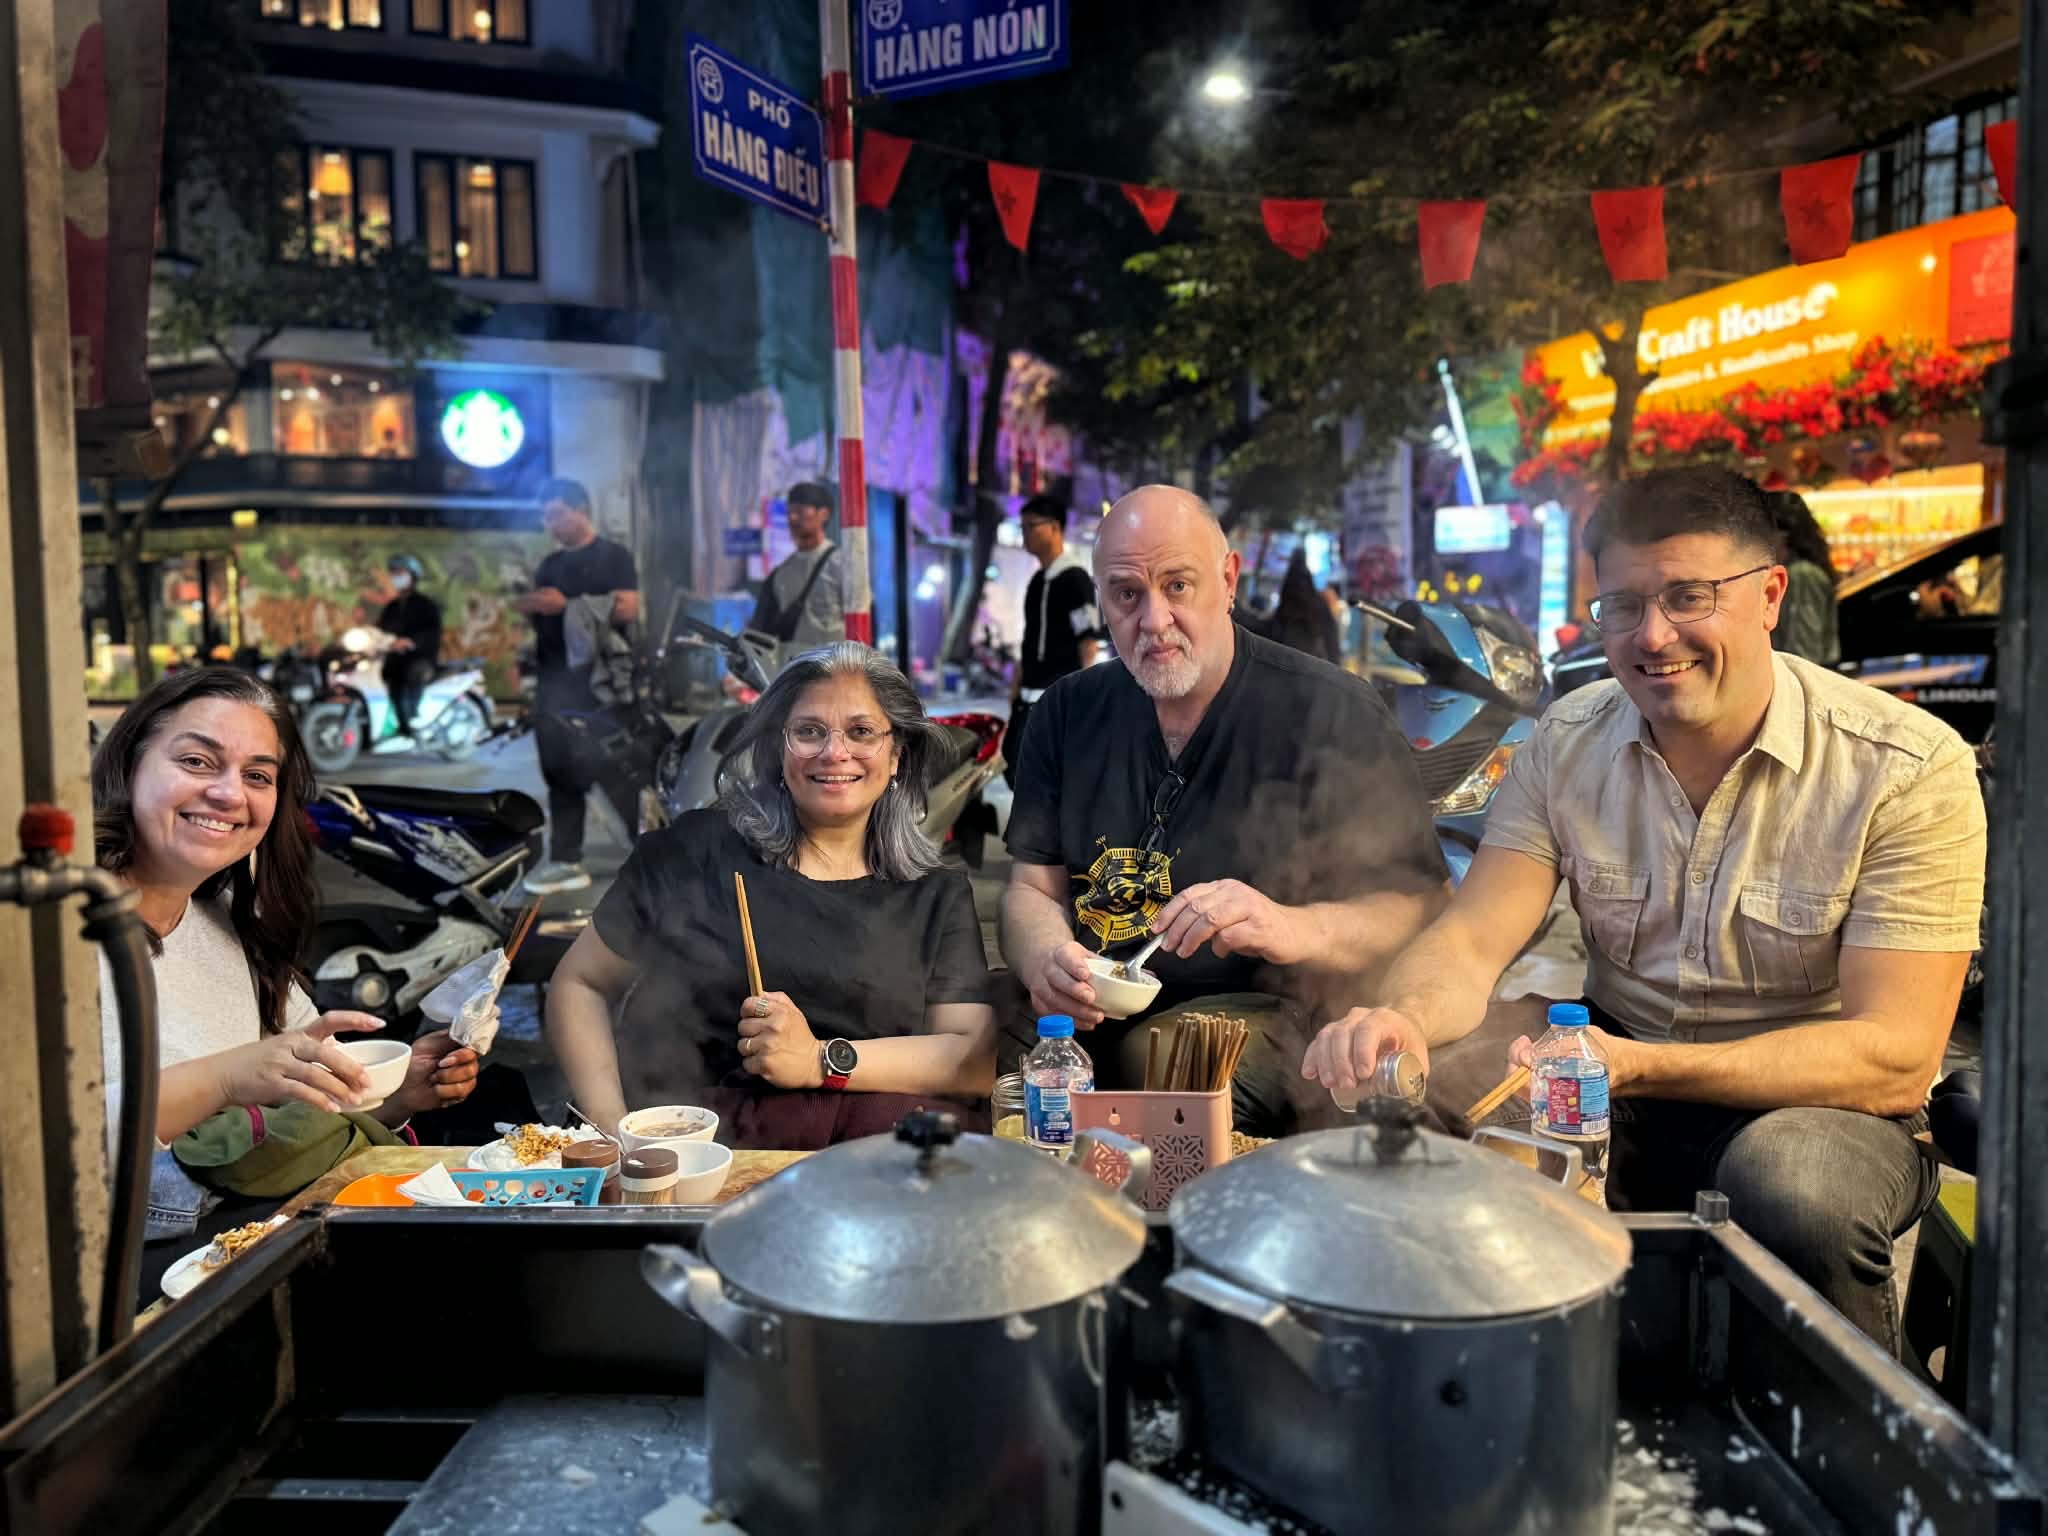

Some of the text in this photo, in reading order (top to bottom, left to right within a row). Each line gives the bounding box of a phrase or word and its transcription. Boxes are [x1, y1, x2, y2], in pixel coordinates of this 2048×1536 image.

[876, 0, 1046, 80] HÀNG NÓN
[703, 109, 769, 184] HÀNG
[748, 88, 791, 129] PHỐ
[1637, 316, 1713, 364] Craft
[1719, 281, 1839, 343] House
